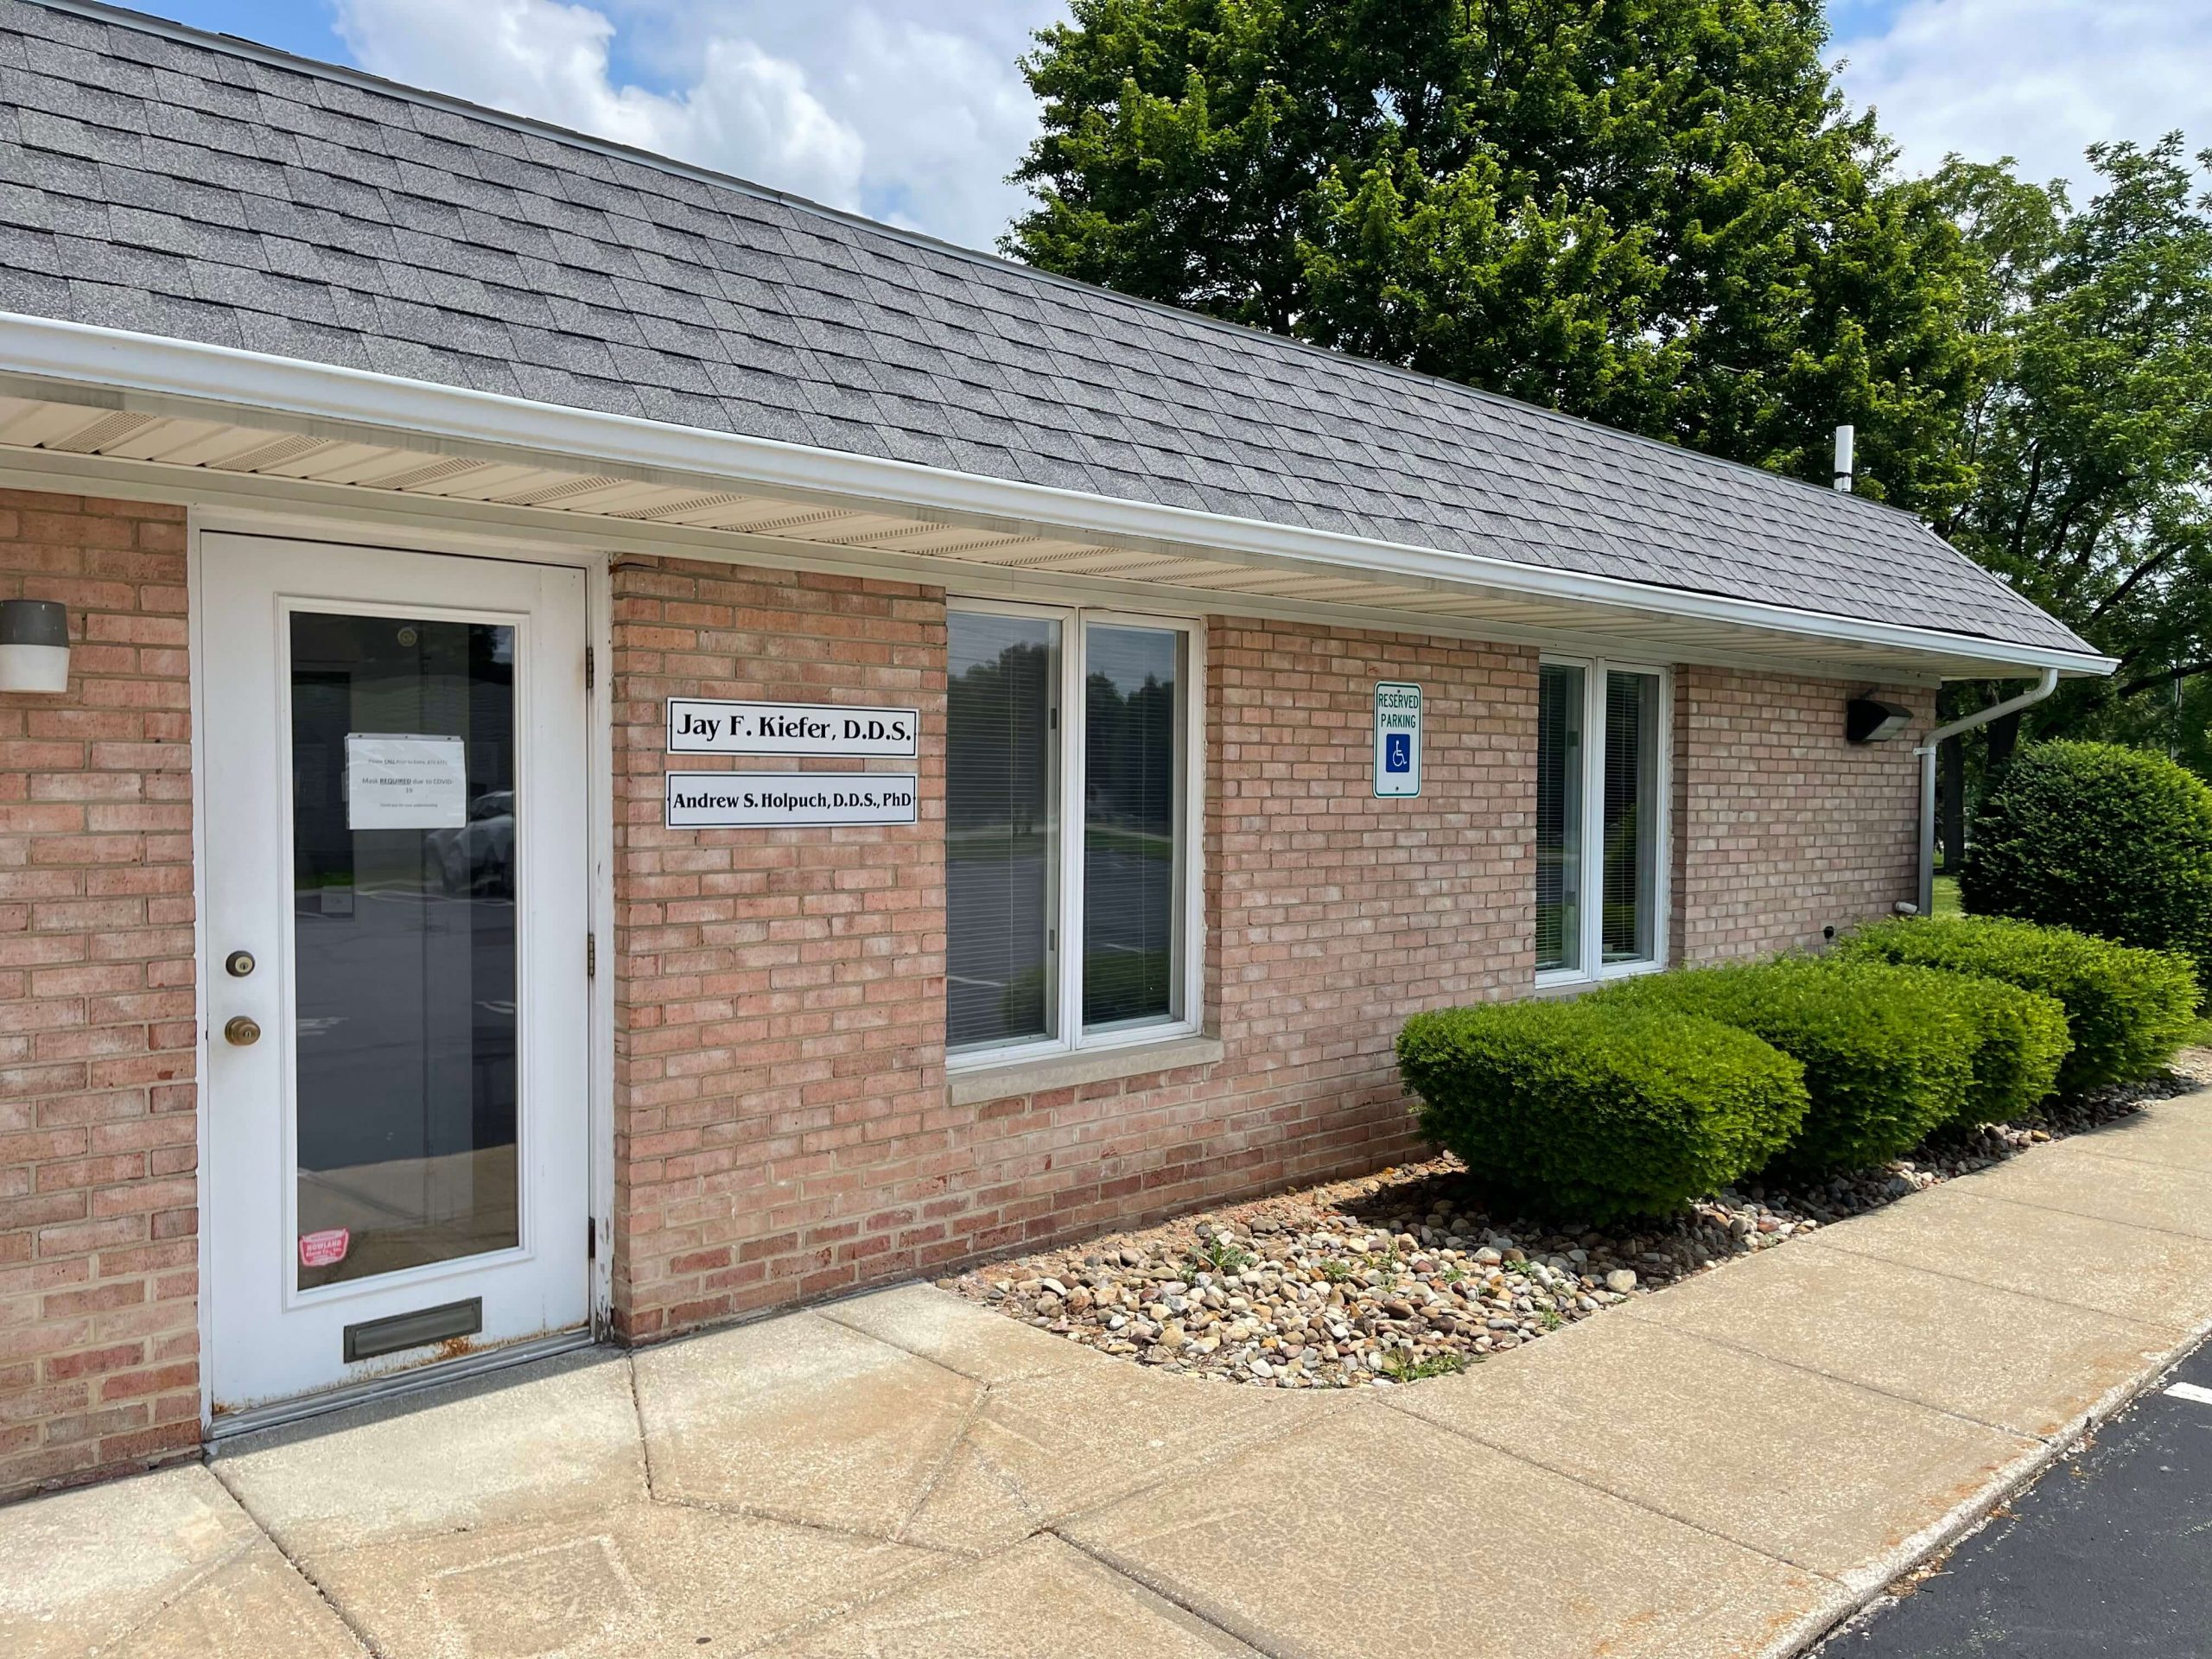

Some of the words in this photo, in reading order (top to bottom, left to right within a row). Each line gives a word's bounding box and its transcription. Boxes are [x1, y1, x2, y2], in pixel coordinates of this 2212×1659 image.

[1378, 693, 1419, 709] RESERVED
[677, 713, 721, 742] Jay
[729, 715, 752, 737] F.
[759, 715, 837, 741] Kiefer,
[843, 721, 912, 741] D.D.S.
[1381, 713, 1416, 728] PARKING
[673, 792, 739, 809] Andrew
[743, 793, 759, 809] S.
[761, 792, 831, 812] Holpuch,
[833, 792, 880, 809] D.D.S.,
[882, 793, 912, 807] PhD
[307, 1239, 342, 1254] HOWLAND
